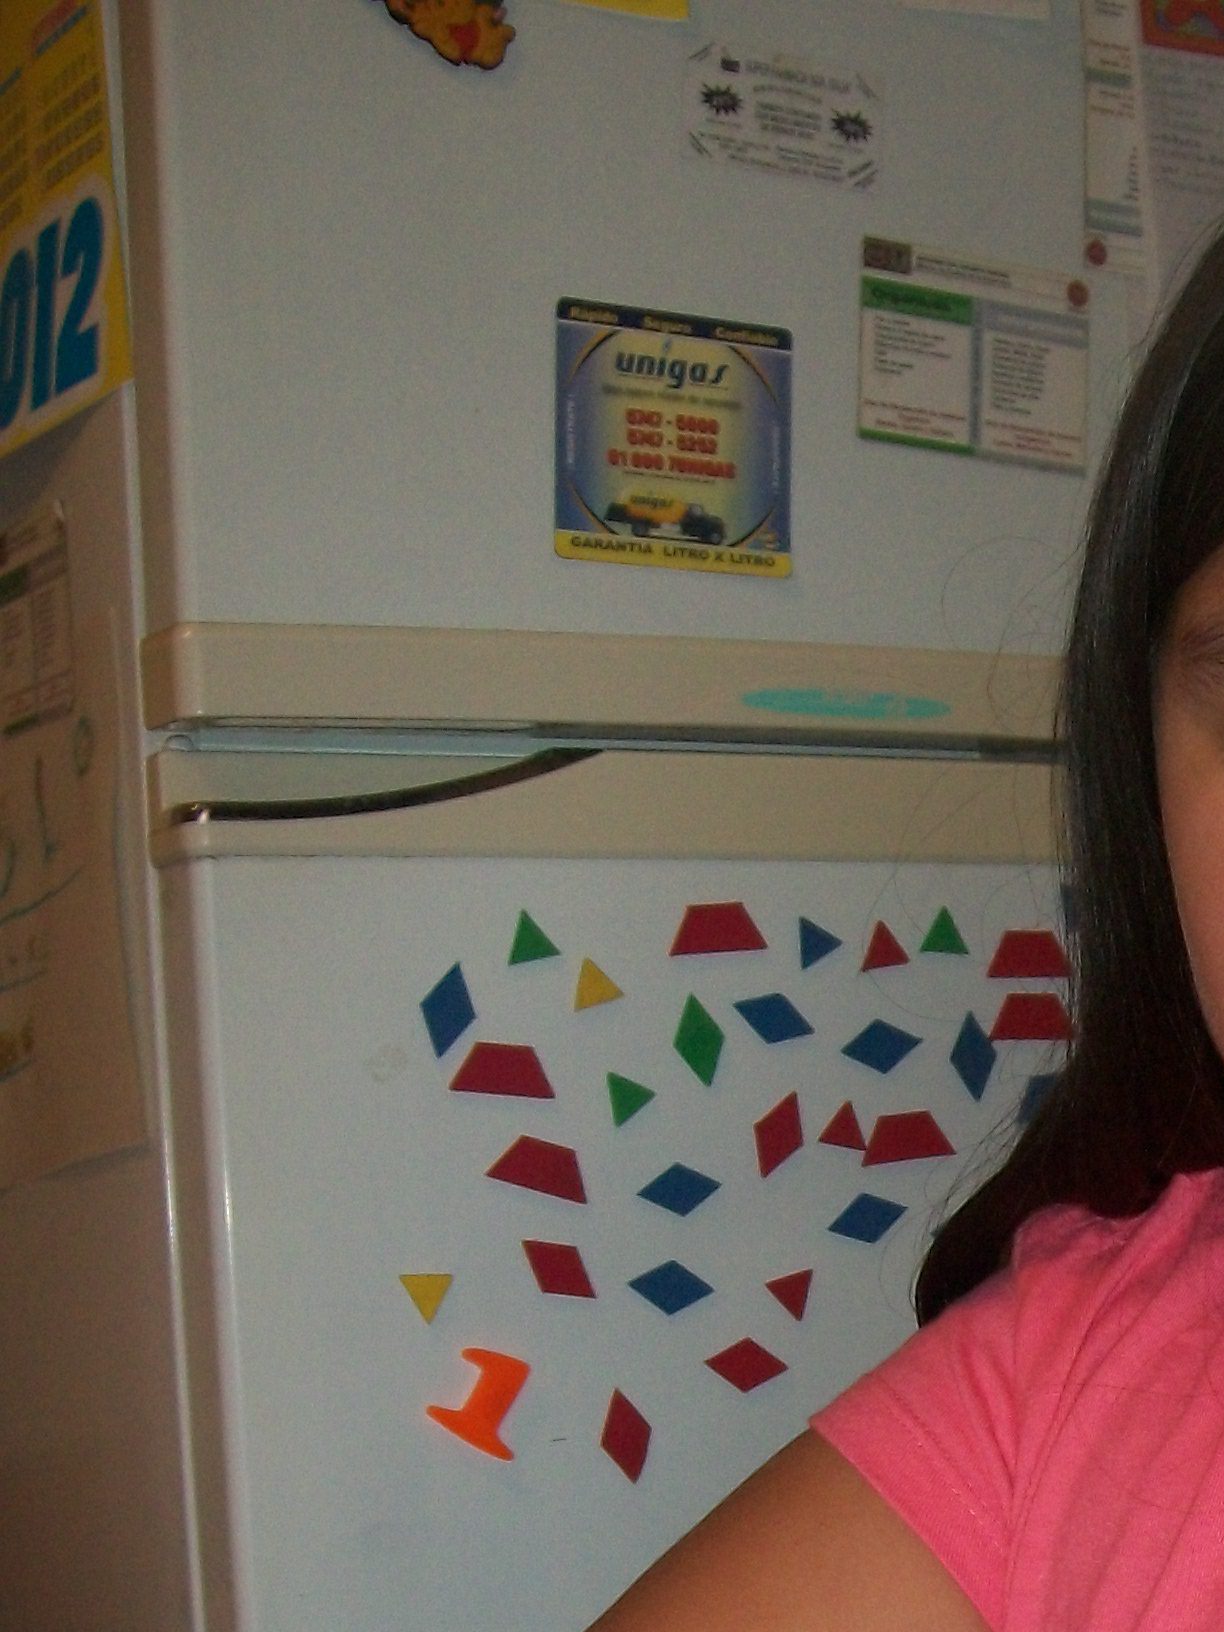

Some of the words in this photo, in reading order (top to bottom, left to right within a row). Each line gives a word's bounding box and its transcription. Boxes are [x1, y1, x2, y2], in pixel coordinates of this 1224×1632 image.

[615, 340, 730, 389] unigas
[663, 546, 711, 561] LITRO
[730, 552, 776, 568] LITRO
